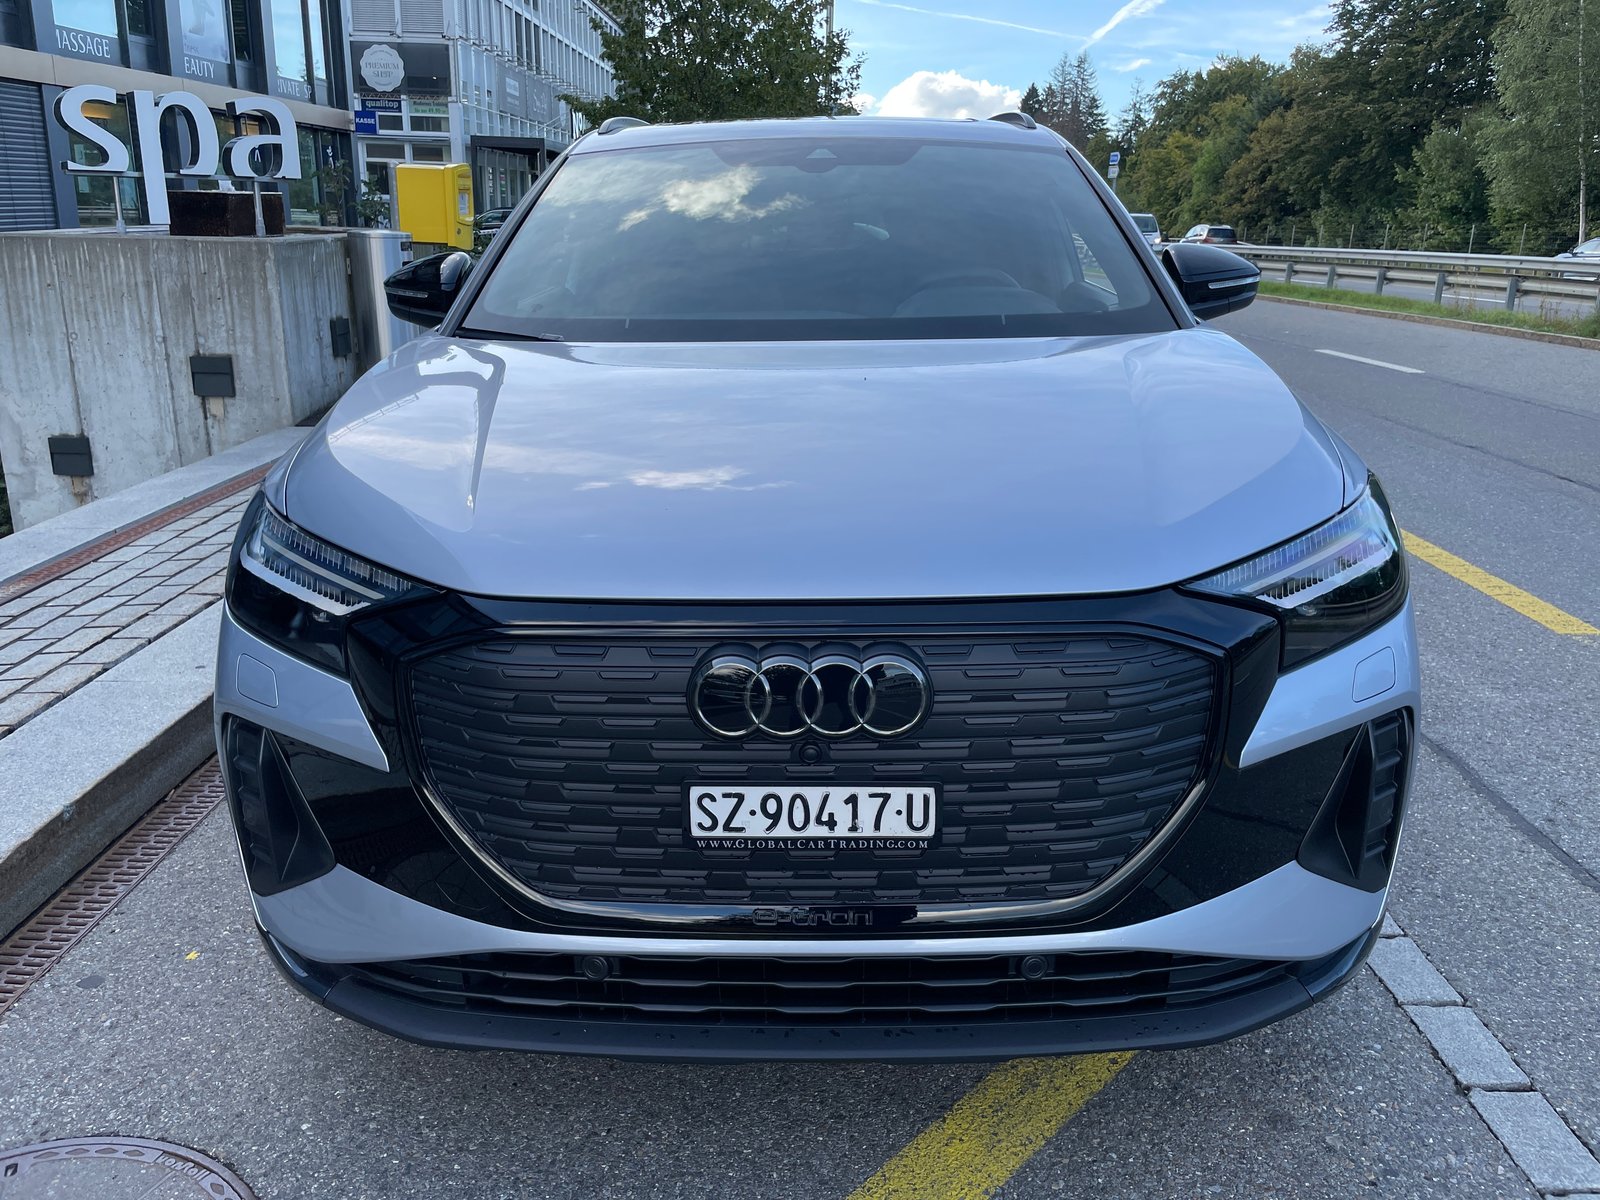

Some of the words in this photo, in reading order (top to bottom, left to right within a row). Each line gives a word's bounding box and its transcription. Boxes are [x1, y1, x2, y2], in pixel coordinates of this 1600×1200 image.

[184, 56, 215, 79] EAUTY
[364, 62, 400, 70] PREMIUM
[303, 84, 312, 99] SP
[365, 100, 399, 109] qualitop
[355, 117, 375, 125] KASSE
[53, 84, 302, 225] spa
[752, 905, 873, 926] e-tron
